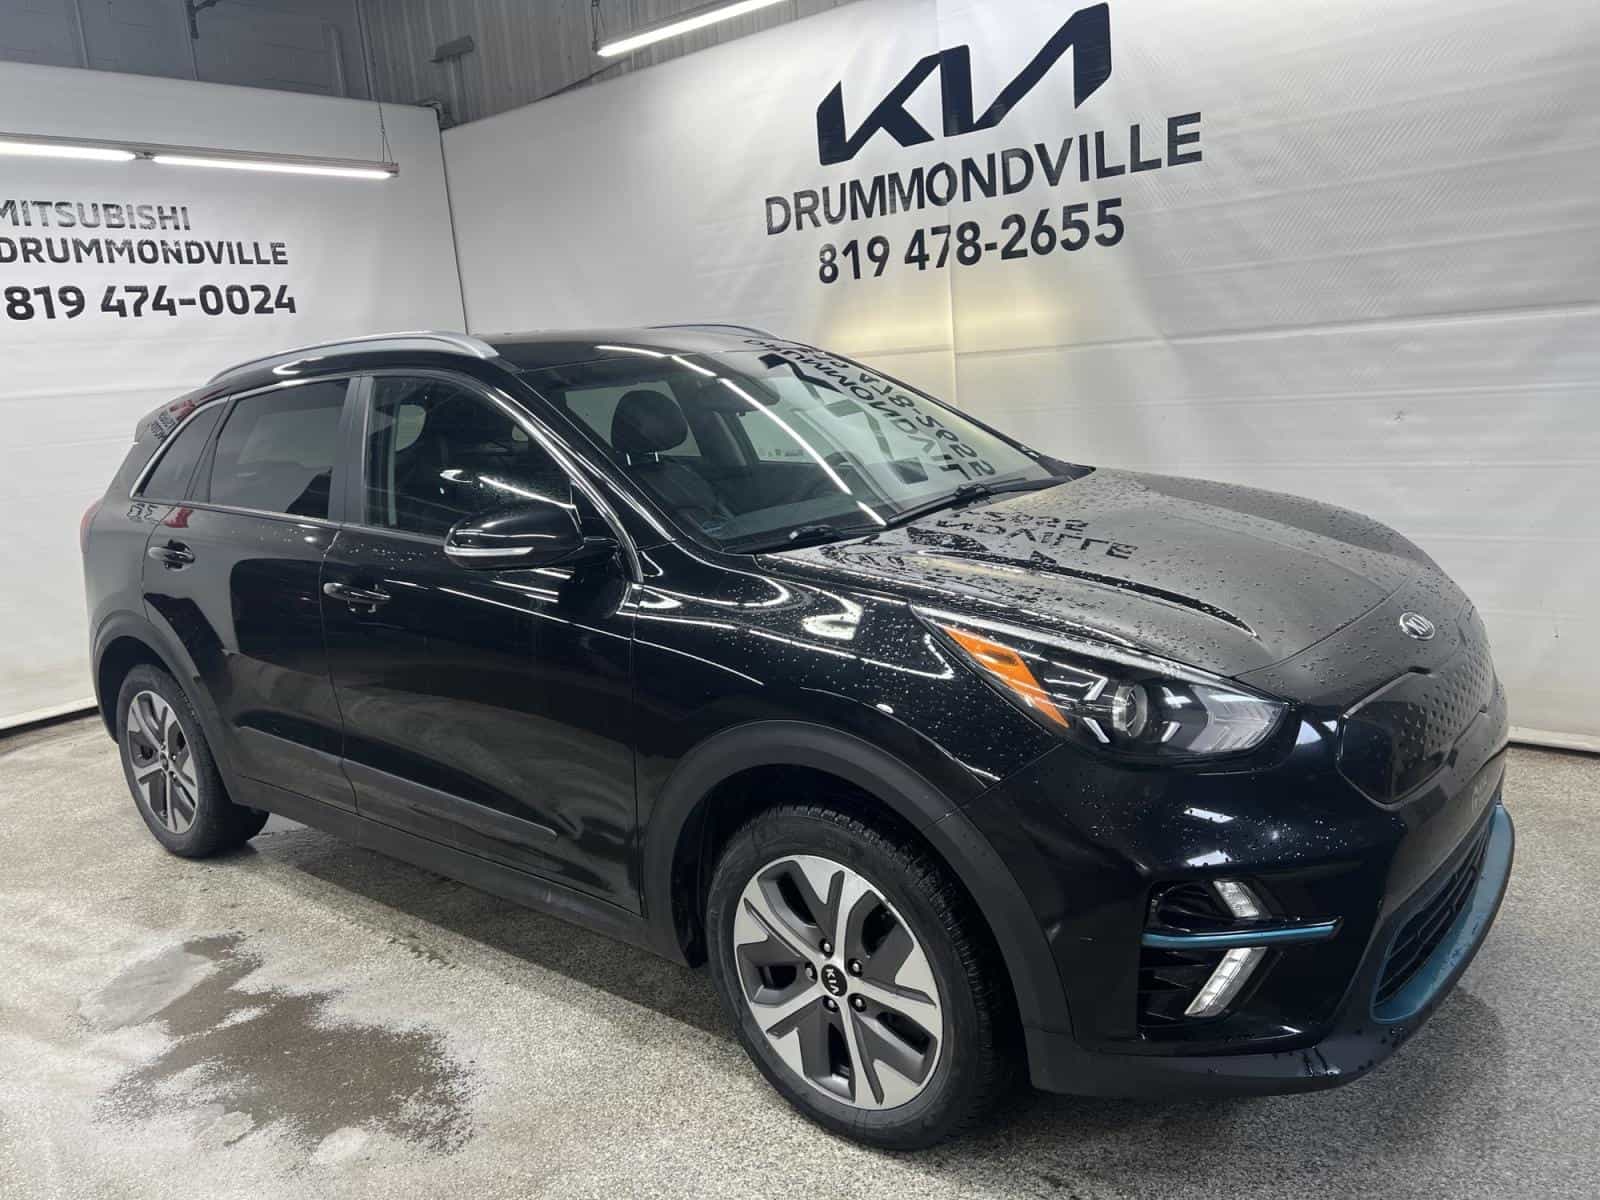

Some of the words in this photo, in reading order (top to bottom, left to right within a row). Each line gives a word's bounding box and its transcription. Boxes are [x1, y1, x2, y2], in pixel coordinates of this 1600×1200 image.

[765, 111, 1202, 236] DRUMMONDVILLE
[0, 237, 288, 265] DRUMMONDVILLE
[818, 235, 890, 284] 819
[904, 198, 1125, 271] 478-2655
[3, 285, 85, 320] 819
[100, 284, 297, 318] 474-0024
[825, 968, 840, 994] KIA
